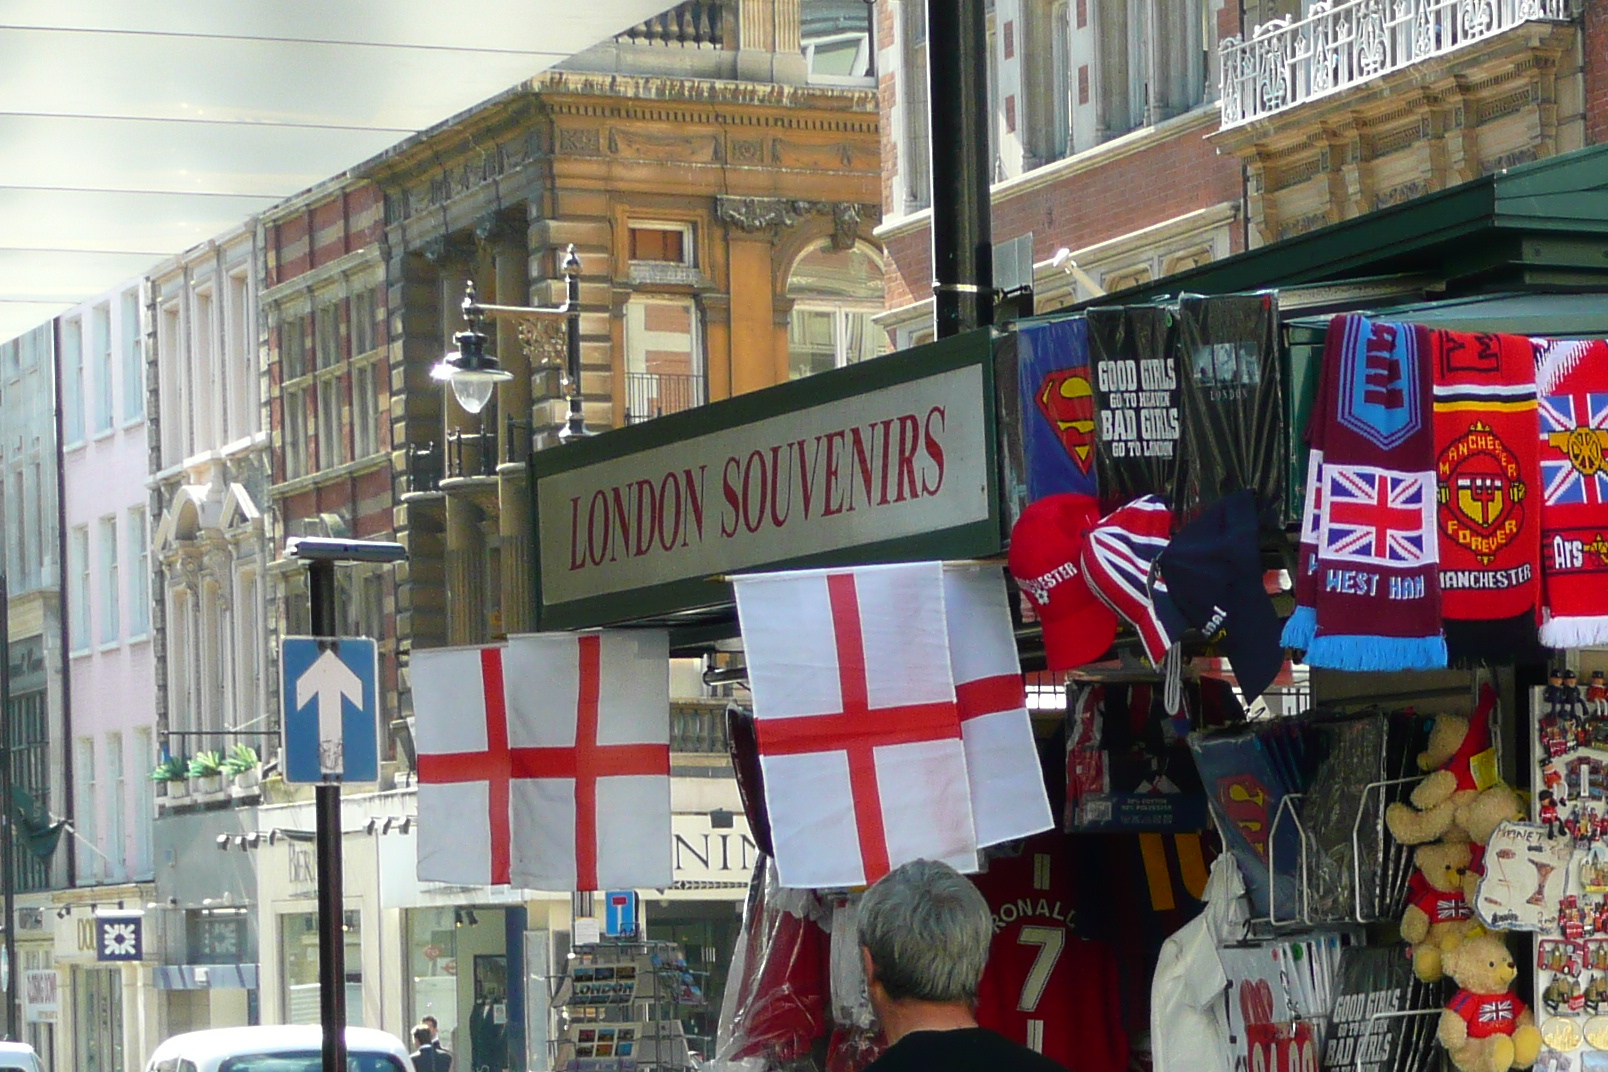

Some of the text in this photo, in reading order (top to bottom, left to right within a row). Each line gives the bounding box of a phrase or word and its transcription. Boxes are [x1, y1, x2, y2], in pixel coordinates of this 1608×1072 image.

[1098, 358, 1177, 392] GOOD GIRLS
[1110, 391, 1171, 408] GO TO HEAVEN
[1209, 389, 1249, 401] LONDON
[1101, 408, 1180, 440] BAD GIRLS
[1111, 442, 1126, 457] GO
[1127, 441, 1141, 457] TO
[1439, 432, 1517, 477] MANCHESTER
[569, 405, 947, 571] LONDON SOUVENIRS
[1447, 519, 1518, 552] FOREVER
[1325, 569, 1380, 597] WEST
[1016, 925, 1066, 1012] 7
[572, 982, 635, 996] LONDON
[1332, 993, 1366, 1024] GOOD
[1324, 1036, 1356, 1067] BAD
